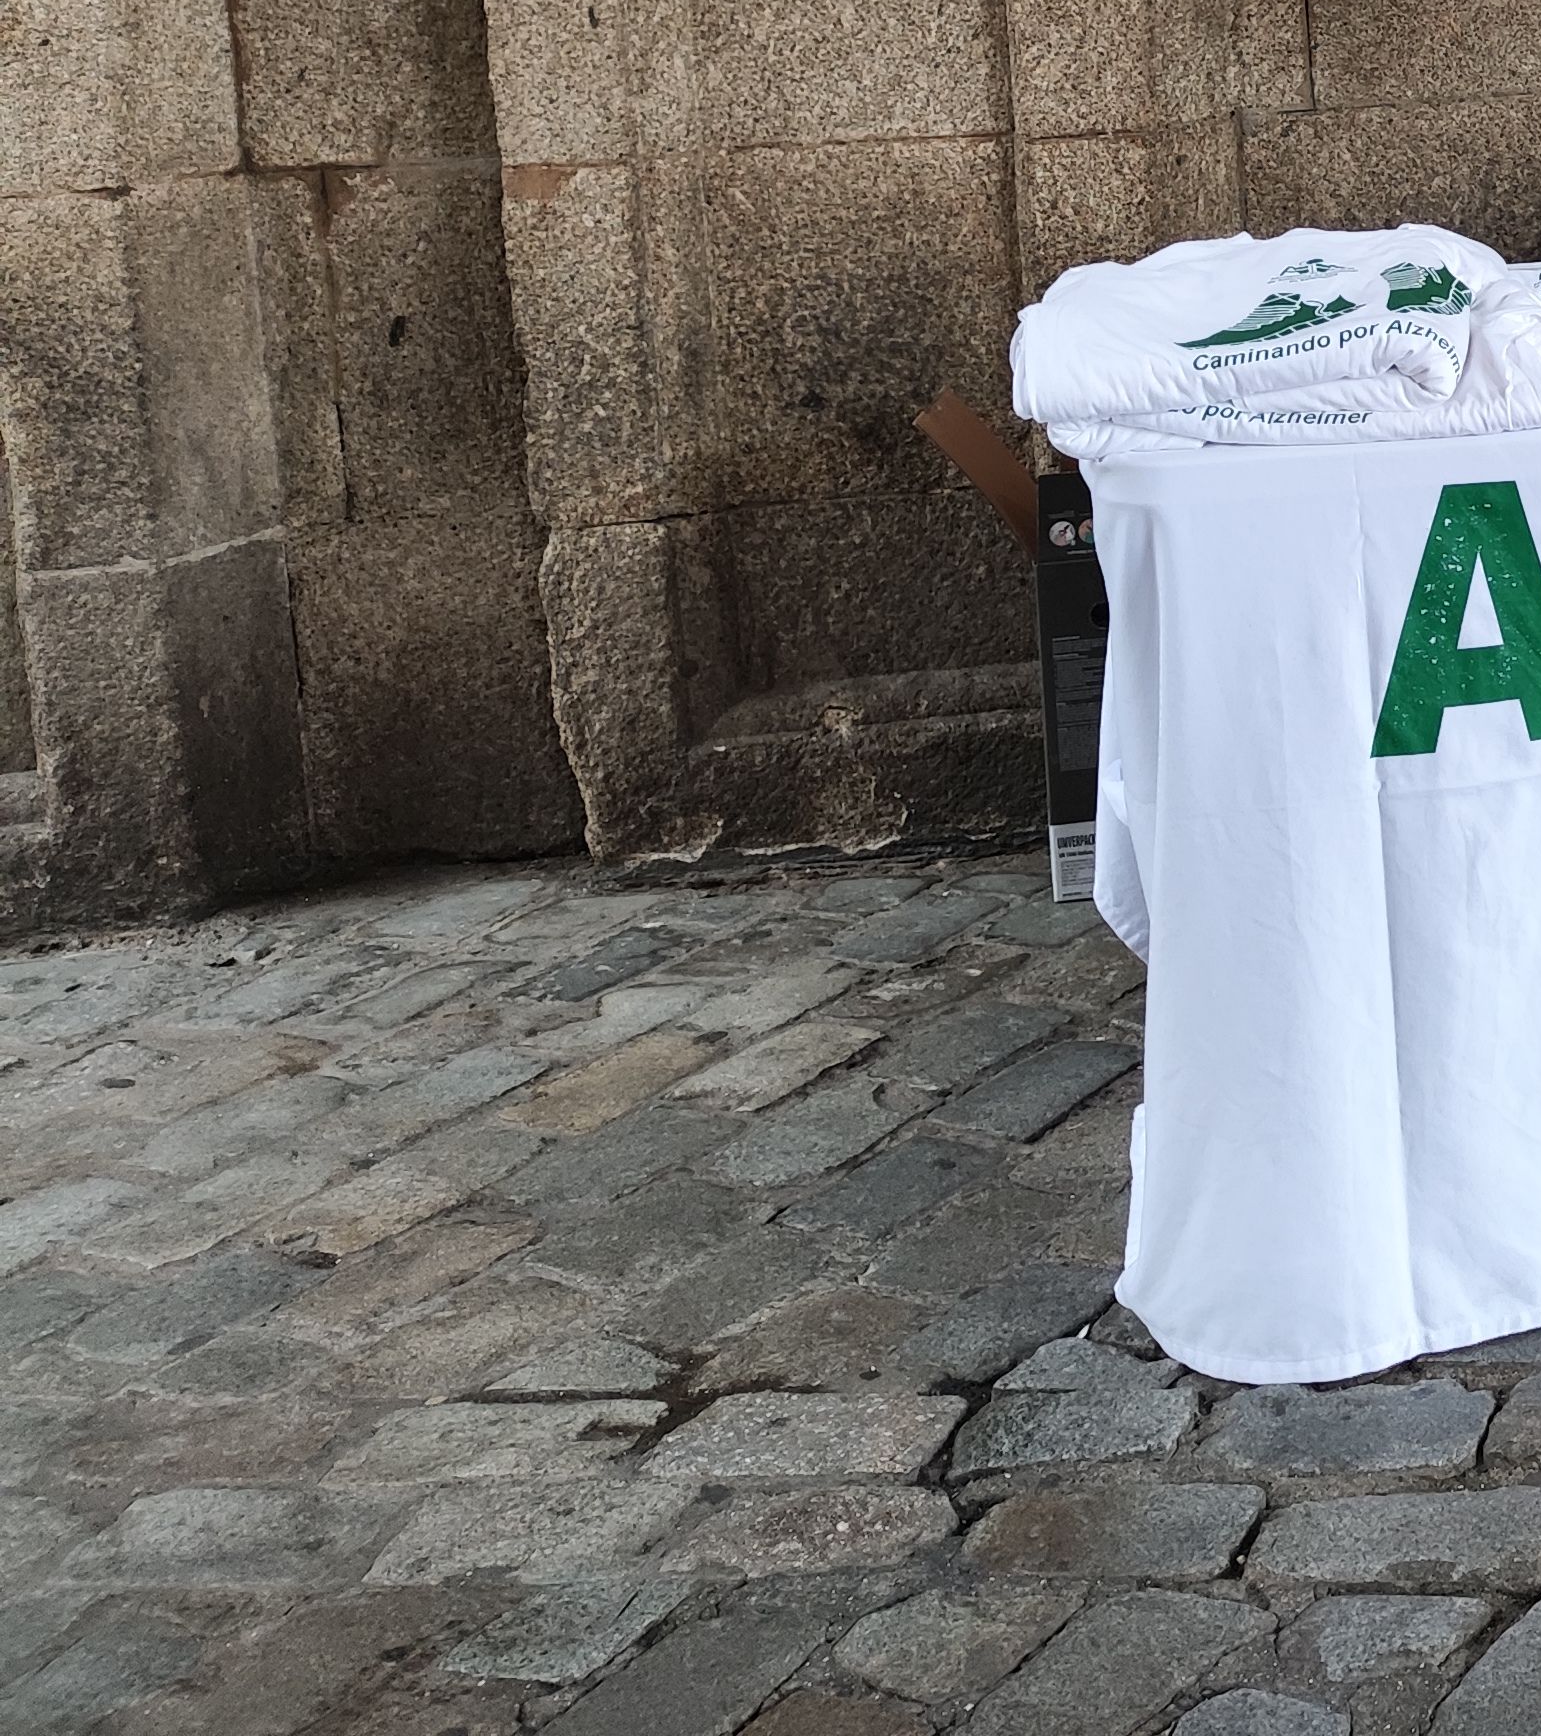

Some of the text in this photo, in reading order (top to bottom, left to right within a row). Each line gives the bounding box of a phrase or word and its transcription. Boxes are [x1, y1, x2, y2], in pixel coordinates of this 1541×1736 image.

[1191, 334, 1331, 372] Caminando
[1338, 323, 1380, 349] por
[1201, 402, 1241, 422] por
